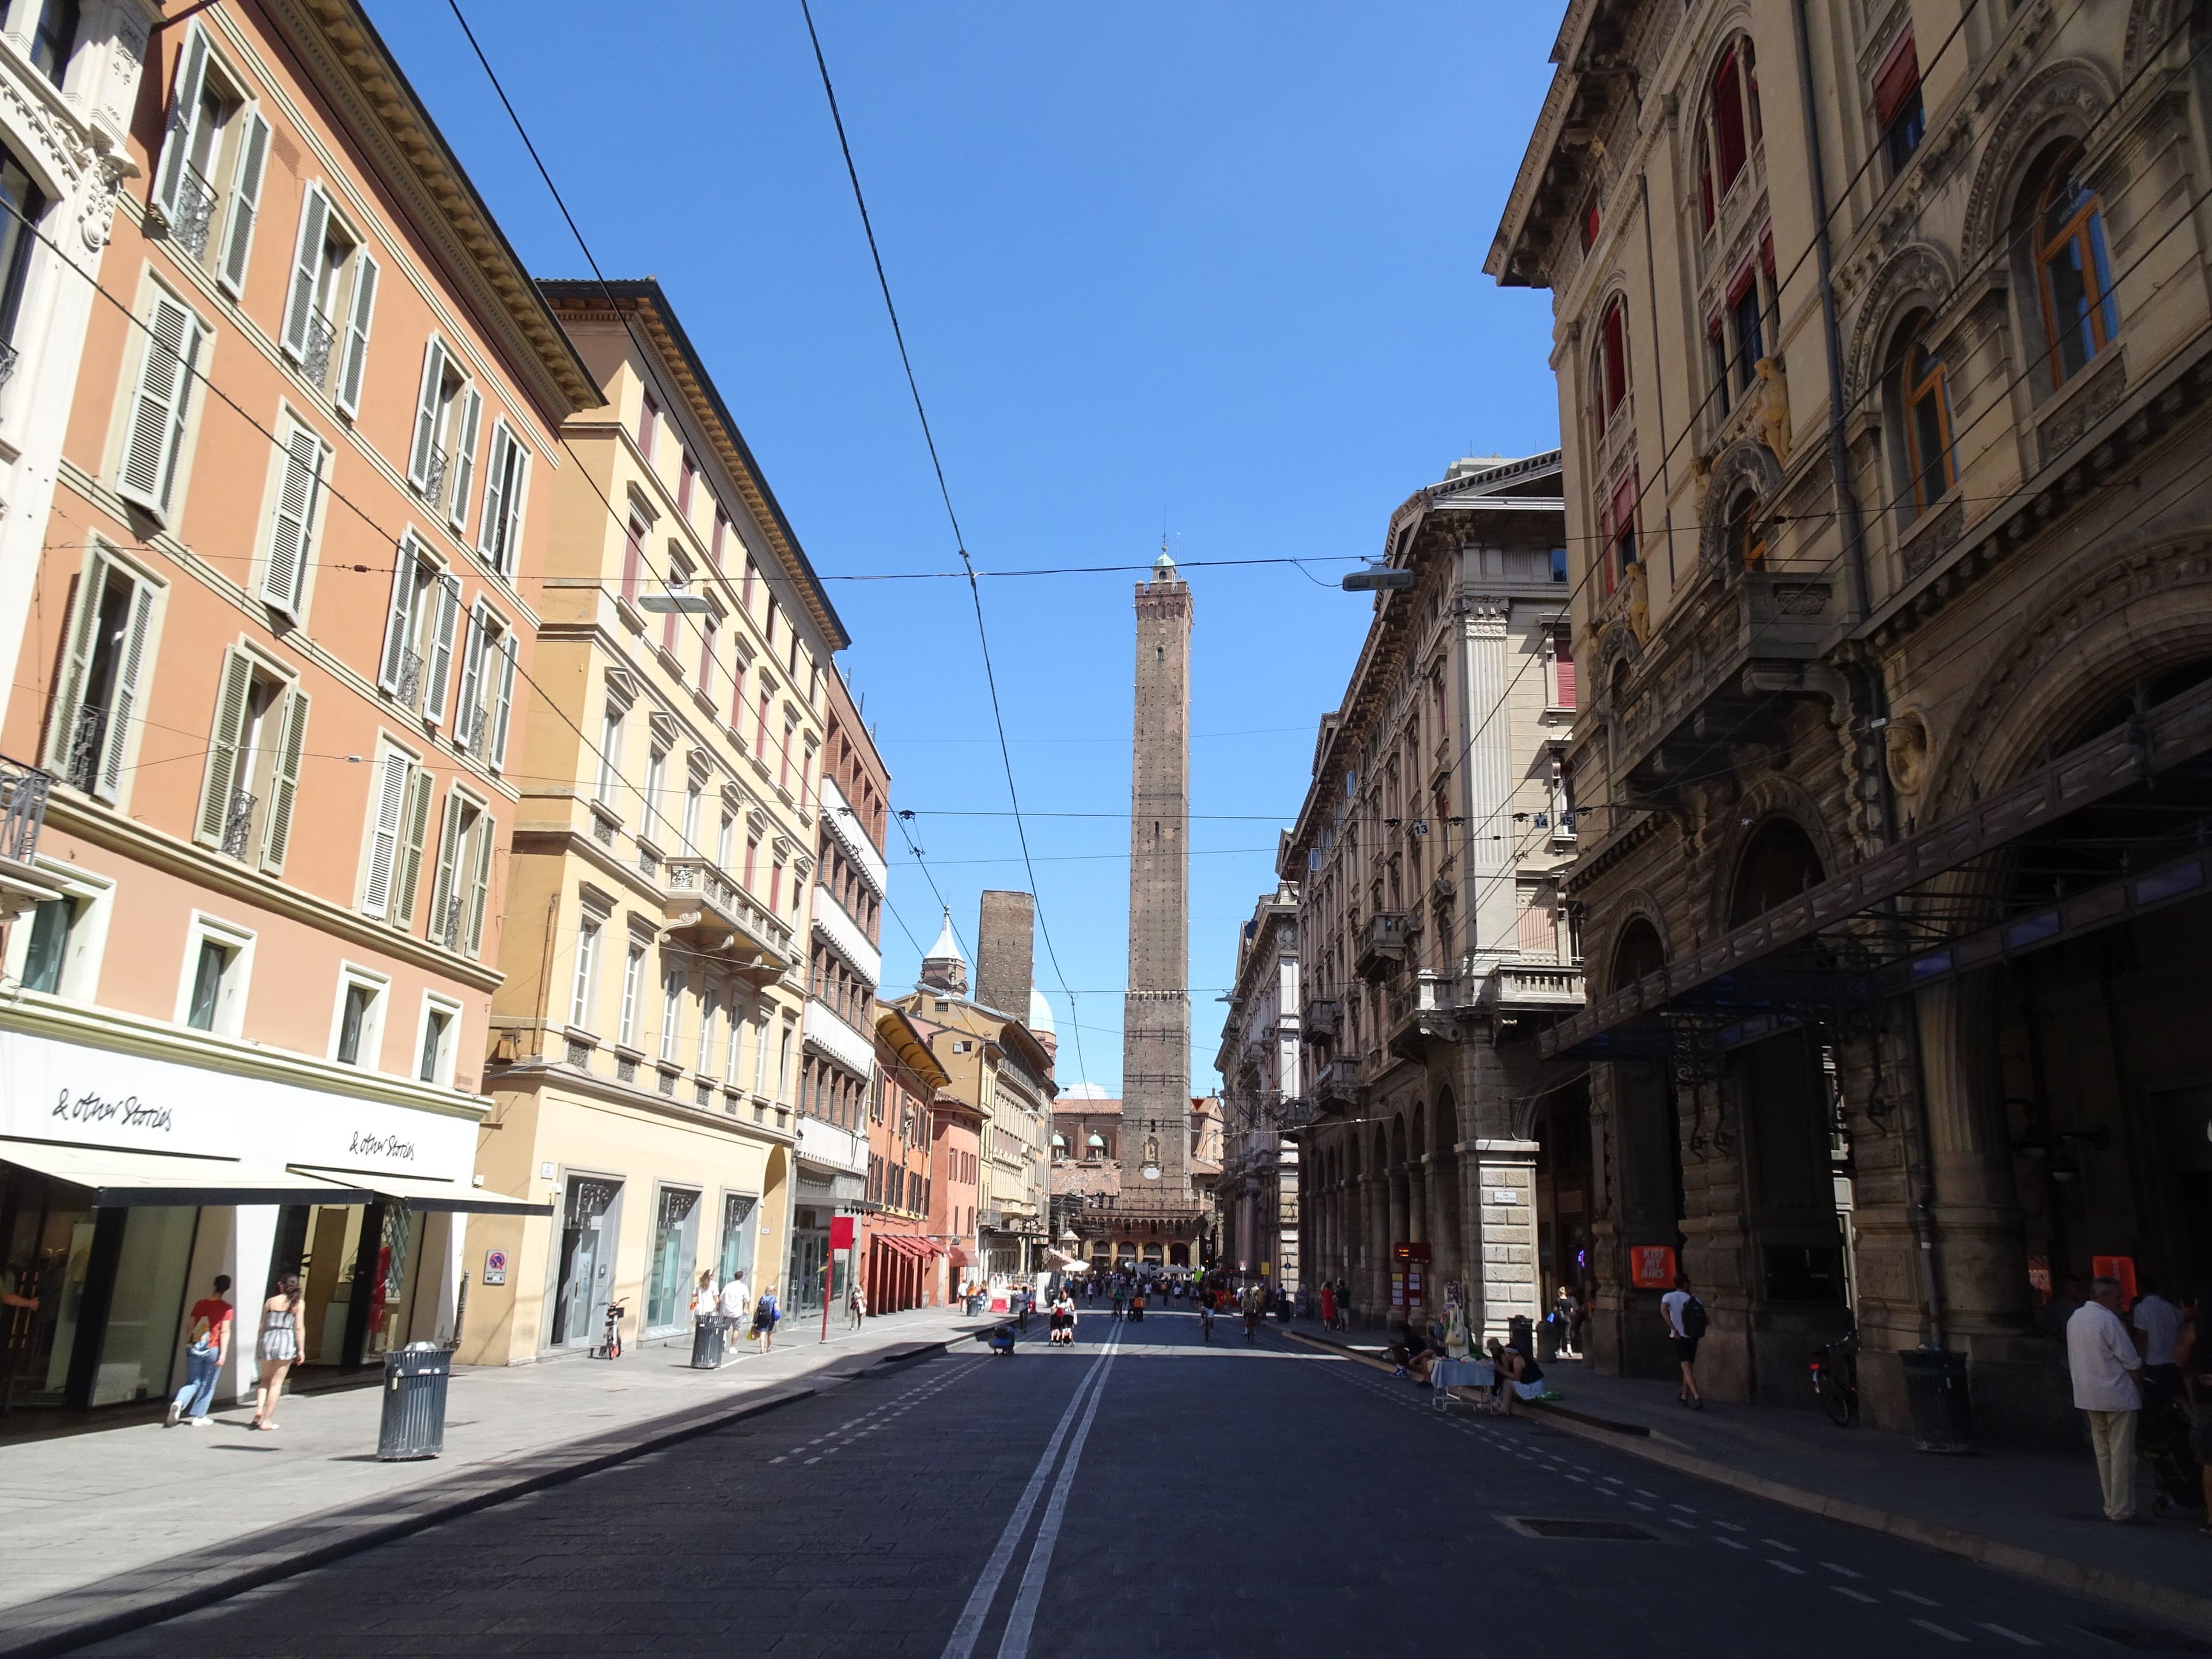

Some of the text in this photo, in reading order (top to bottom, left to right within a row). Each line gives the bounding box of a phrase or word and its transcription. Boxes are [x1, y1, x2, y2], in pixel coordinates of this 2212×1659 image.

[1535, 819, 1548, 827] 14
[1562, 817, 1573, 825] 15
[1414, 825, 1428, 835] 13
[51, 1088, 173, 1132] & other Stories
[349, 1131, 415, 1161] & other Stories
[1643, 1248, 1664, 1258] KISS
[1645, 1258, 1661, 1268] MY
[1641, 1268, 1664, 1279] AIRS
